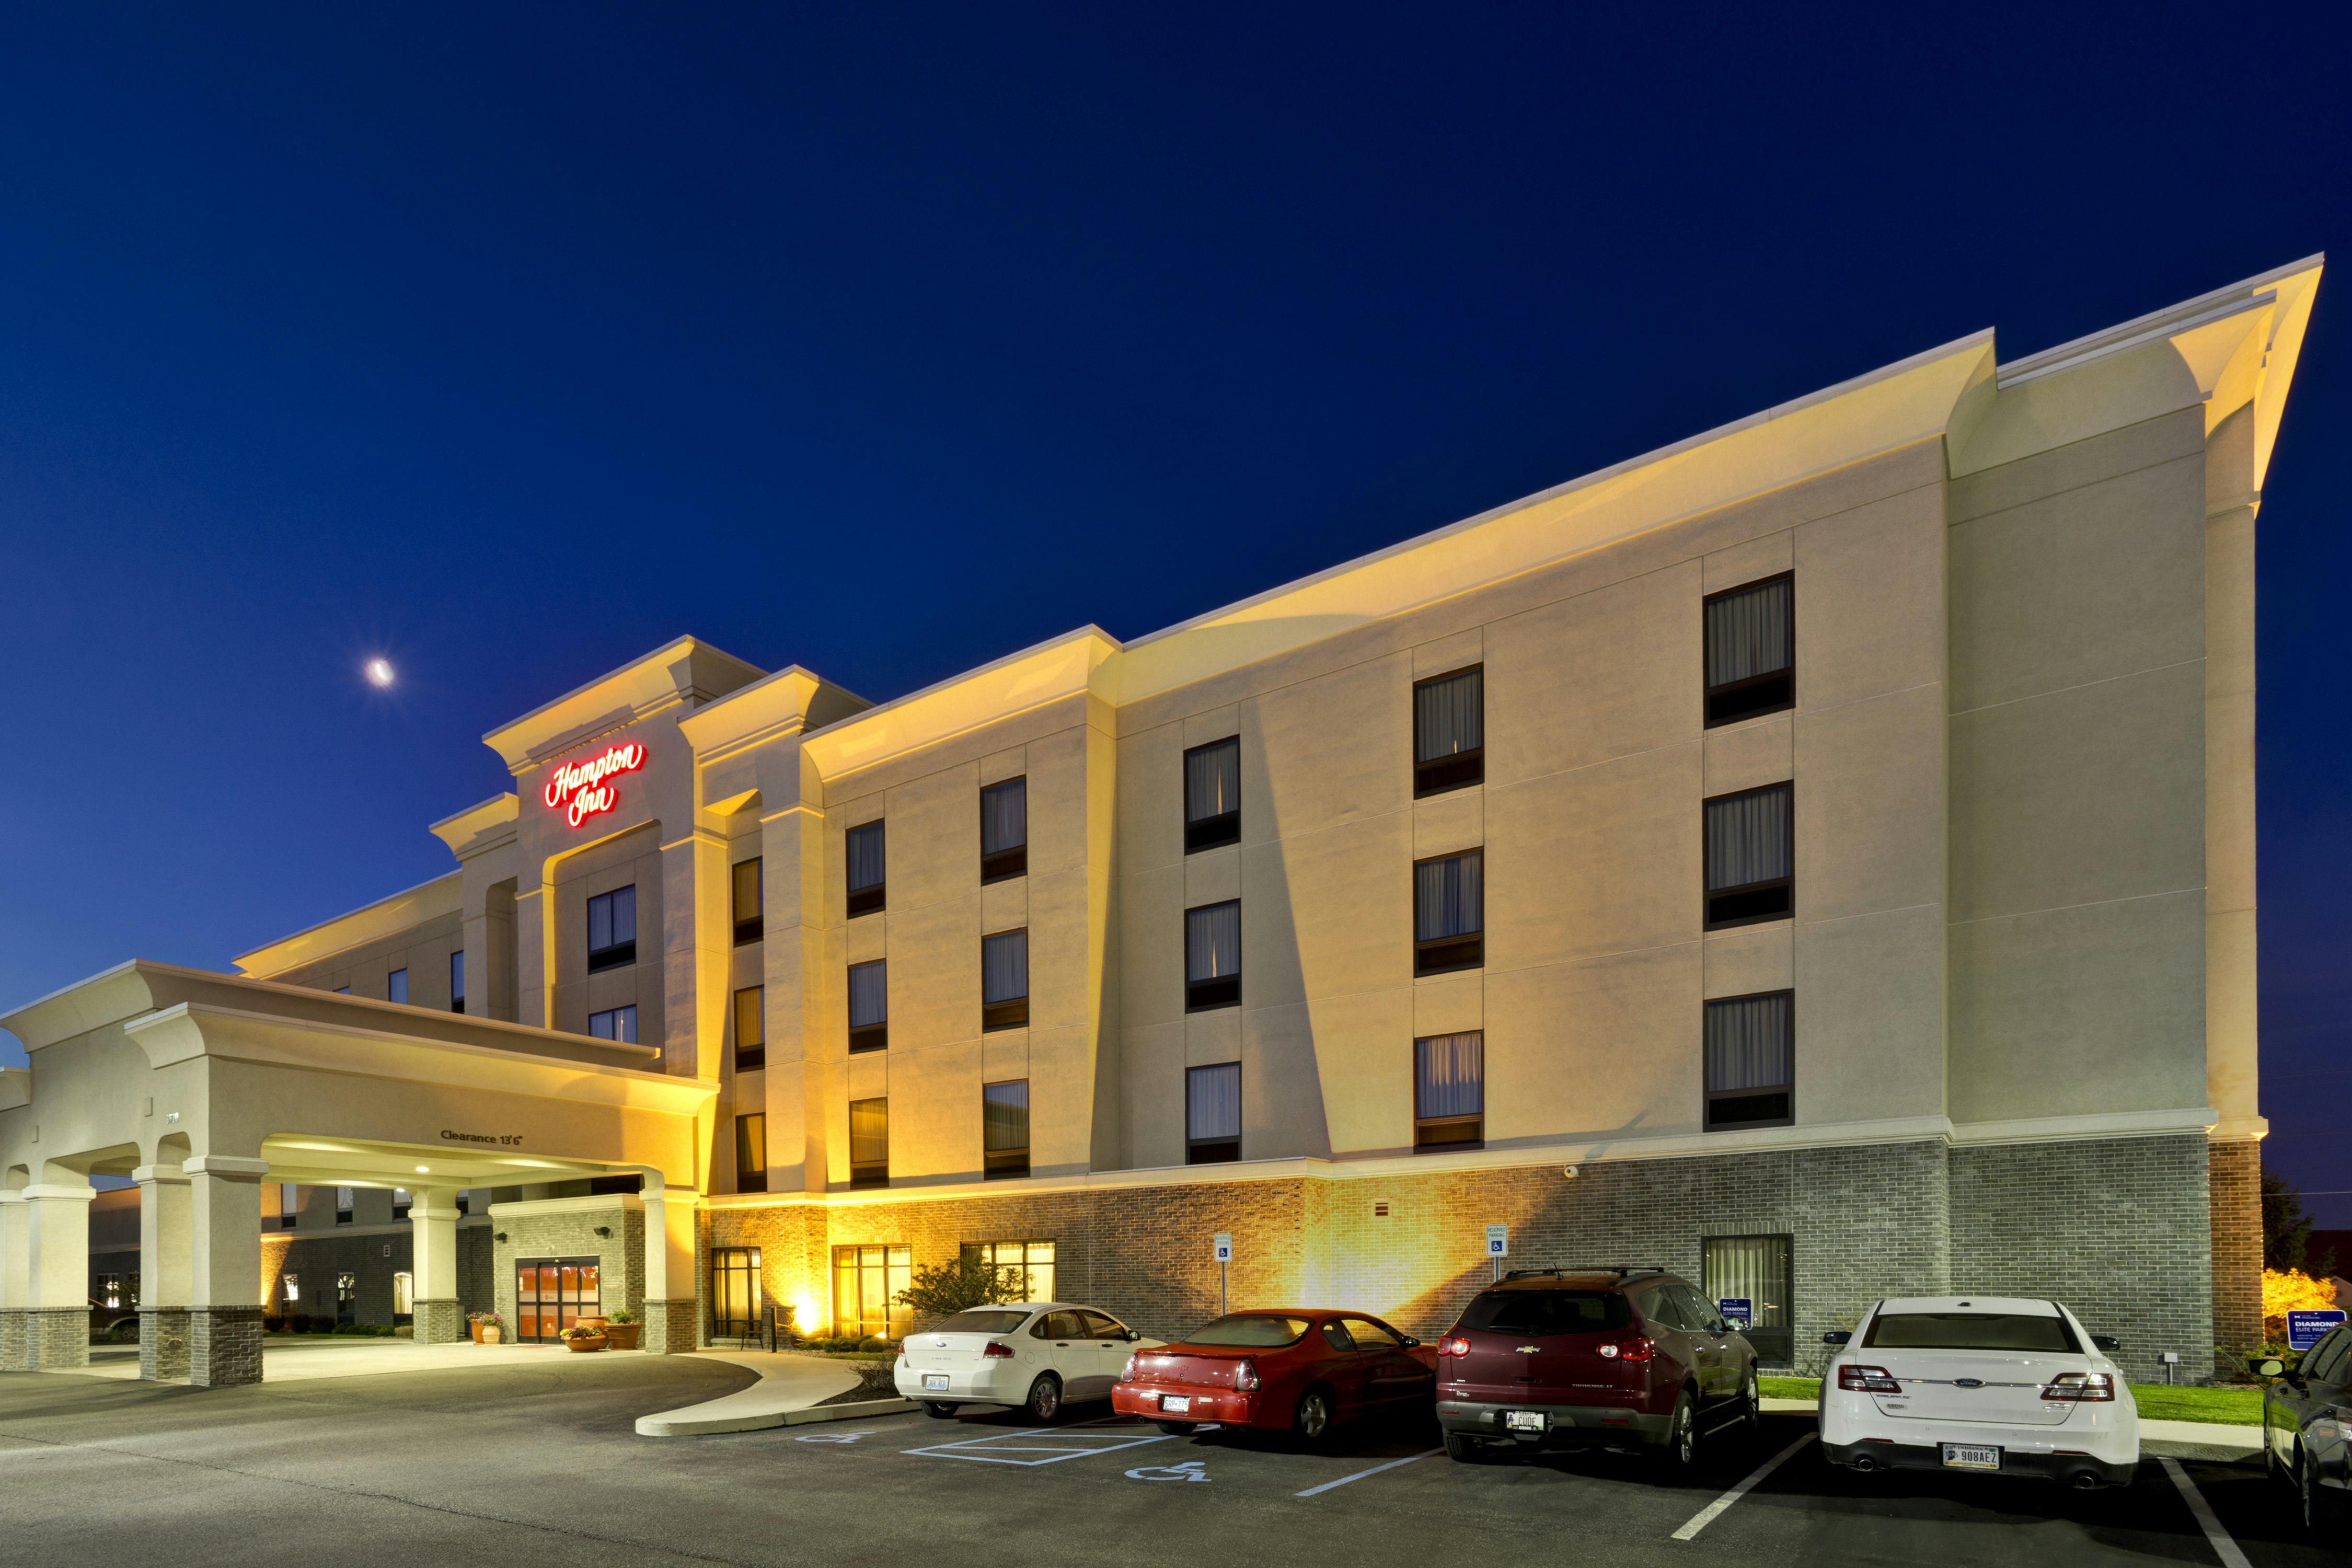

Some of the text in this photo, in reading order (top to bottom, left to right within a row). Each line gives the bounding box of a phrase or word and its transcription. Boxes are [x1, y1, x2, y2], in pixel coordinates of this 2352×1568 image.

[545, 744, 644, 807] Hampton
[568, 785, 616, 826] Inn
[441, 1130, 497, 1143] Clearance
[1962, 1451, 1997, 1463] 908AEZ
